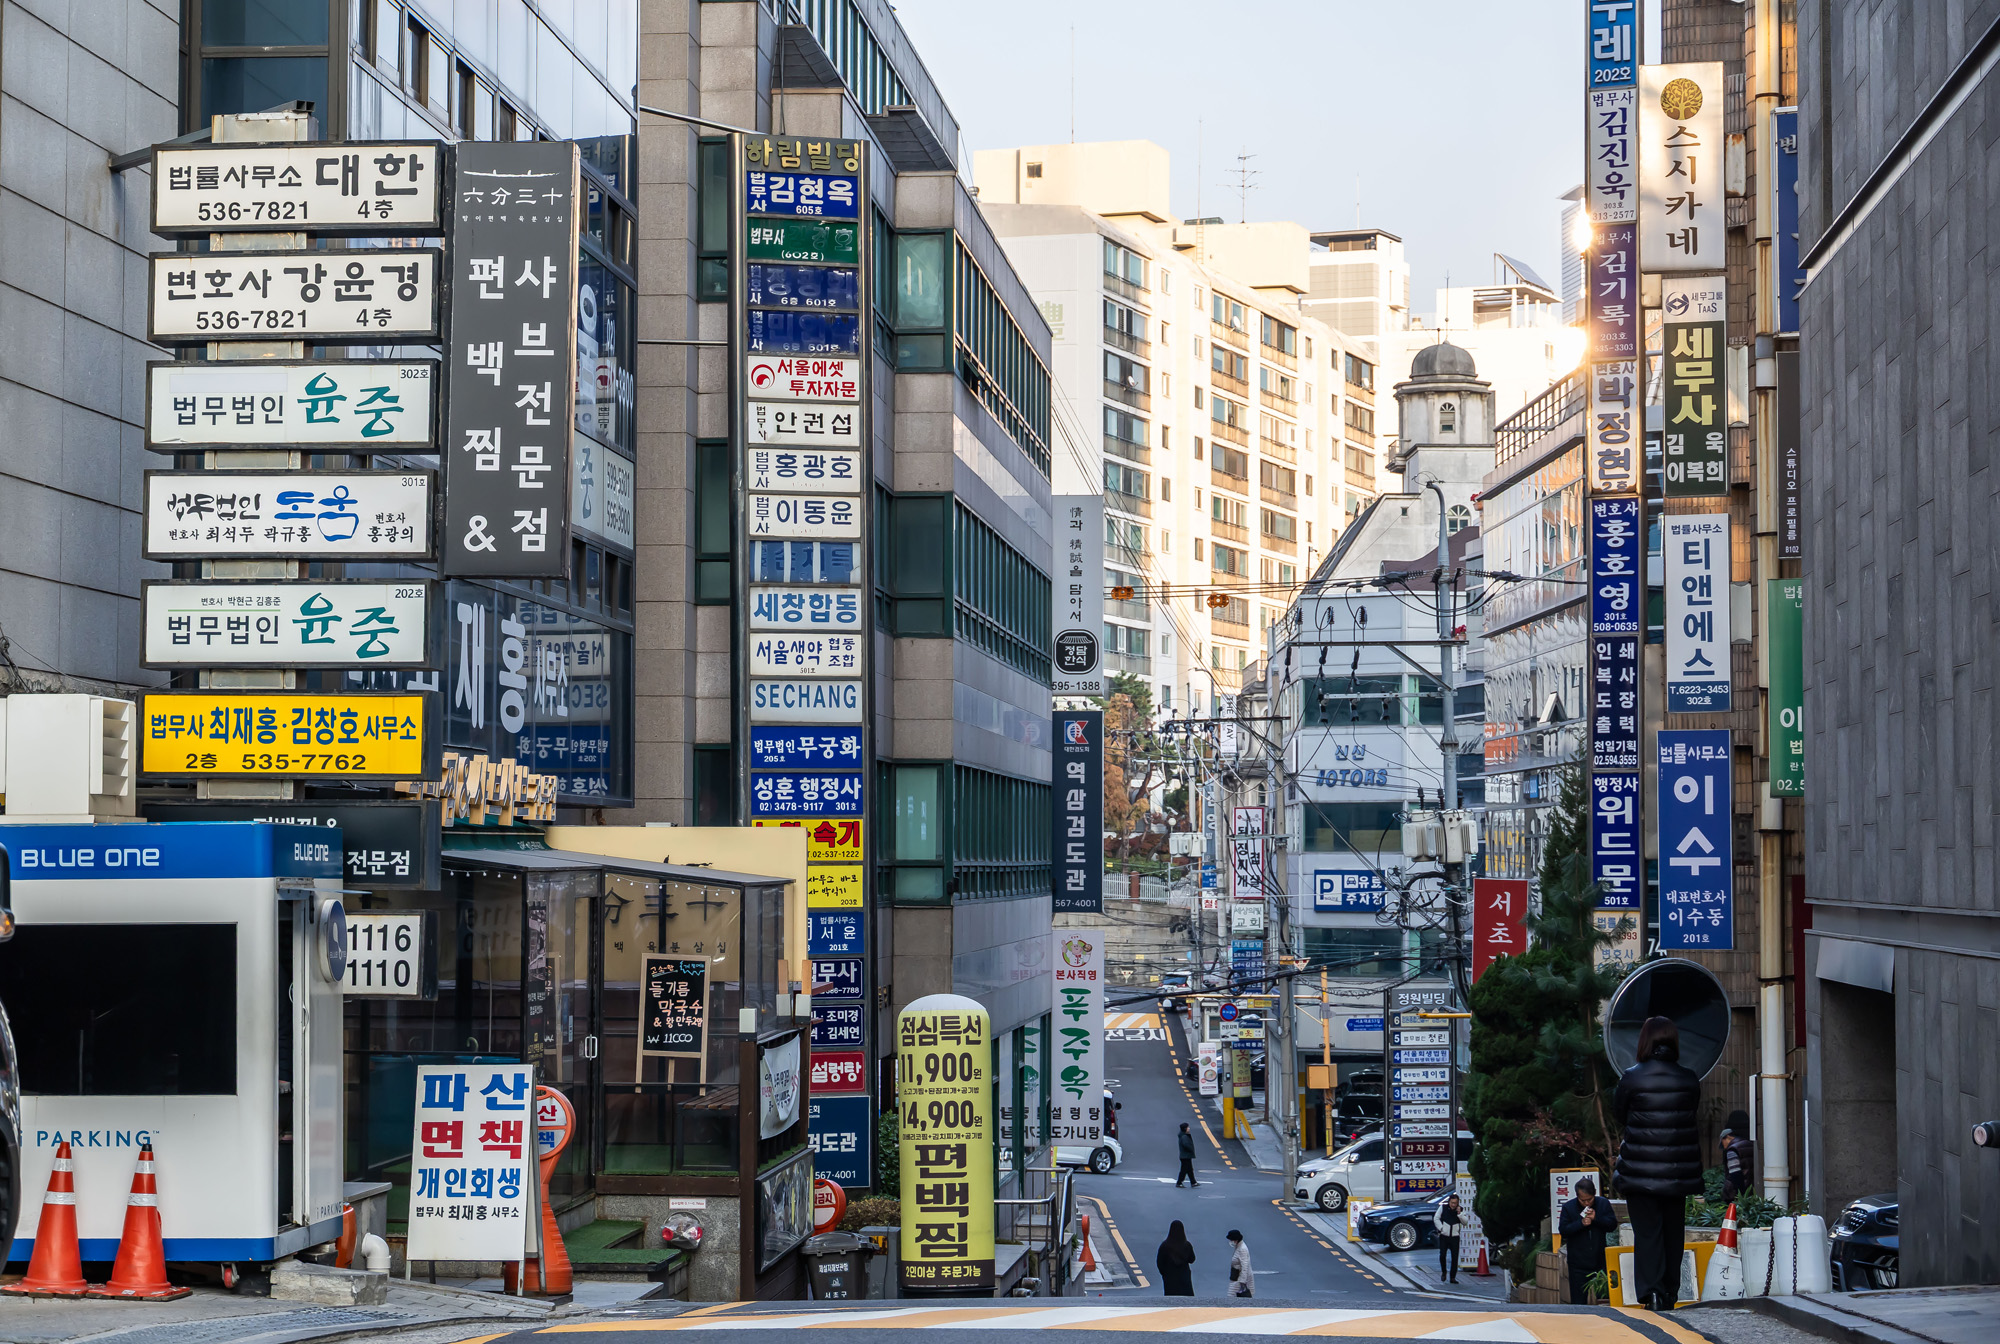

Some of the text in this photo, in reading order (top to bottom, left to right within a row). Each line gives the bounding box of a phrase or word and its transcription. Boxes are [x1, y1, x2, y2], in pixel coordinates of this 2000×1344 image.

[1594, 66, 1632, 83] 202호
[1592, 90, 1634, 108] 법무사
[745, 138, 860, 172] 하림빌딩
[1597, 107, 1633, 201] 김진욱
[169, 154, 424, 196] 법률사무소 대한
[463, 187, 563, 206] 六分三十
[750, 172, 854, 213] 법무사 김현옥
[1663, 125, 1704, 256] 스시카네
[198, 199, 394, 221] 536-7821 4층
[796, 204, 823, 215] 605호
[1603, 201, 1625, 210] 303호
[750, 227, 785, 246] 법무사
[1595, 231, 1632, 245] 법무사
[781, 250, 825, 261] (602호)
[167, 262, 419, 302] 변호사 강윤경
[1597, 250, 1632, 327] 김기록
[806, 298, 837, 308] 601호
[1691, 291, 1724, 302] 세무그룹
[196, 308, 392, 330] 536-7821 4층
[1600, 331, 1628, 342] 203호
[400, 368, 430, 380] 302호
[777, 359, 844, 378] 서울에셋
[1595, 361, 1636, 376] 변호사
[1670, 327, 1718, 426] 세무사
[789, 379, 857, 398] 투자자문
[173, 371, 405, 438] 법무법인 윤중
[756, 405, 852, 442] 법무사 안권섭
[1597, 376, 1635, 481] 박정현
[755, 451, 853, 489] 법무사 홍광호
[1666, 460, 1725, 483] 이복희
[1786, 448, 1797, 491] 스튜디오
[401, 477, 426, 488] 301호
[1601, 481, 1628, 493] 2층
[167, 485, 359, 542] 법무법인 도움
[755, 496, 853, 534] 법무사 이동윤
[1594, 501, 1639, 518] 변호사
[375, 512, 406, 525] 변호사
[169, 526, 414, 544] 변호사 최석두 곽규홍 홍광의
[1671, 523, 1724, 536] 법률사무소
[1785, 545, 1800, 554] B102
[1595, 519, 1636, 611] 홍호영
[201, 597, 223, 607] 변호사
[227, 595, 253, 607] 박현근
[395, 588, 425, 600] 202호
[753, 593, 857, 624] 세창합동
[1681, 537, 1716, 677] 티앤에스
[168, 592, 400, 659] 법무법인 윤중
[1604, 612, 1628, 622] 301호
[1593, 622, 1639, 632] 508-0635
[756, 637, 856, 666] 서울생약 협동
[1064, 645, 1088, 656] 정담
[1596, 642, 1636, 662] 인쇄
[828, 653, 856, 668] 조합
[1064, 655, 1088, 667] 한식
[800, 667, 817, 675] 501호
[1596, 666, 1636, 686] 복사
[1051, 681, 1101, 691] 595-1388
[1669, 685, 1730, 696] T.6223-3453
[754, 683, 857, 709] SECHANG
[1596, 691, 1636, 710] 도장
[1686, 696, 1713, 705] 302호
[151, 713, 204, 741] 법무사
[363, 715, 417, 741] 사무소
[1595, 715, 1636, 735] 출력
[754, 735, 861, 760] 법무법인 무궁화
[1594, 740, 1638, 753] 천일기획
[1660, 743, 1729, 765] 법률사무소
[185, 753, 367, 771] 2층 535-7762
[764, 755, 786, 764] 205호
[1593, 754, 1638, 766] 02.594.3555
[754, 776, 862, 801] 성훈 행정사
[1594, 776, 1639, 793] 행정사
[835, 802, 857, 812] 301호
[1065, 761, 1087, 892] 역삼검도관
[1669, 775, 1722, 877] 이수
[347, 849, 411, 877] 전문점
[1236, 826, 1249, 888] 된장찌개
[840, 874, 858, 884] 바로
[1358, 876, 1383, 889] 유료
[840, 898, 858, 906] 203호
[1055, 899, 1096, 908] 567-4001
[1604, 896, 1630, 906] 501호
[1666, 889, 1727, 905] 대표변호사
[820, 916, 856, 925] 법률사무소
[1237, 917, 1262, 929] 교회
[1668, 907, 1725, 927] 이수동
[1683, 933, 1711, 944] 201호
[829, 943, 849, 952] 201호
[1055, 969, 1097, 981] 본사직영
[648, 980, 691, 998] 들기름
[1398, 992, 1446, 1006] 정원빌딩
[658, 999, 704, 1017] 막국수
[901, 1014, 982, 1047] 점심특선
[1394, 1033, 1400, 1044] 5
[1059, 987, 1092, 1101] 푸주옥
[1394, 1051, 1401, 1062] 4
[1394, 1070, 1401, 1080] 4
[421, 1072, 530, 1112] 파산
[1394, 1089, 1400, 1099] 3
[1051, 1106, 1101, 1121] 설렁탕
[420, 1120, 524, 1160] 면책
[1051, 1125, 1101, 1140] 도가니탕
[416, 1167, 521, 1199] 개인회생
[815, 1170, 857, 1180] 567-4001
[1408, 1178, 1445, 1189] 유료주차
[914, 1142, 970, 1259] 편백찜
[416, 1204, 520, 1221] 법무사 최재홍 사무소
[905, 1264, 982, 1278] 2인이상 주문가능
